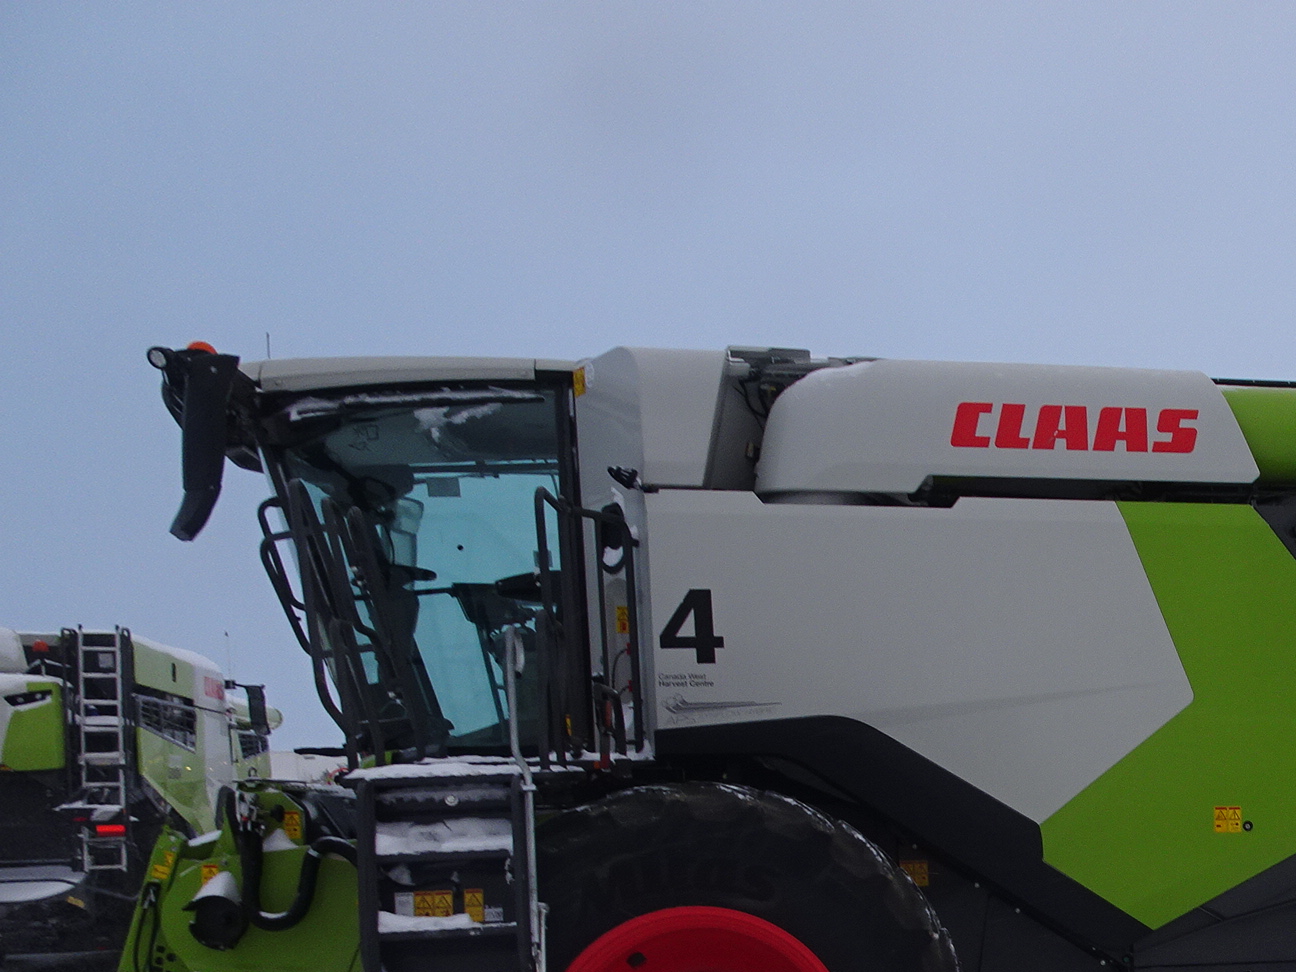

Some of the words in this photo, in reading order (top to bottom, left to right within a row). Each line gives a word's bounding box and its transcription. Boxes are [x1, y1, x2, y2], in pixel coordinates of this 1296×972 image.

[950, 402, 1199, 454] CLAAS
[659, 588, 725, 664] 4
[658, 672, 687, 680] Canada
[658, 680, 688, 688] Harvest
[689, 680, 715, 688] Centre
